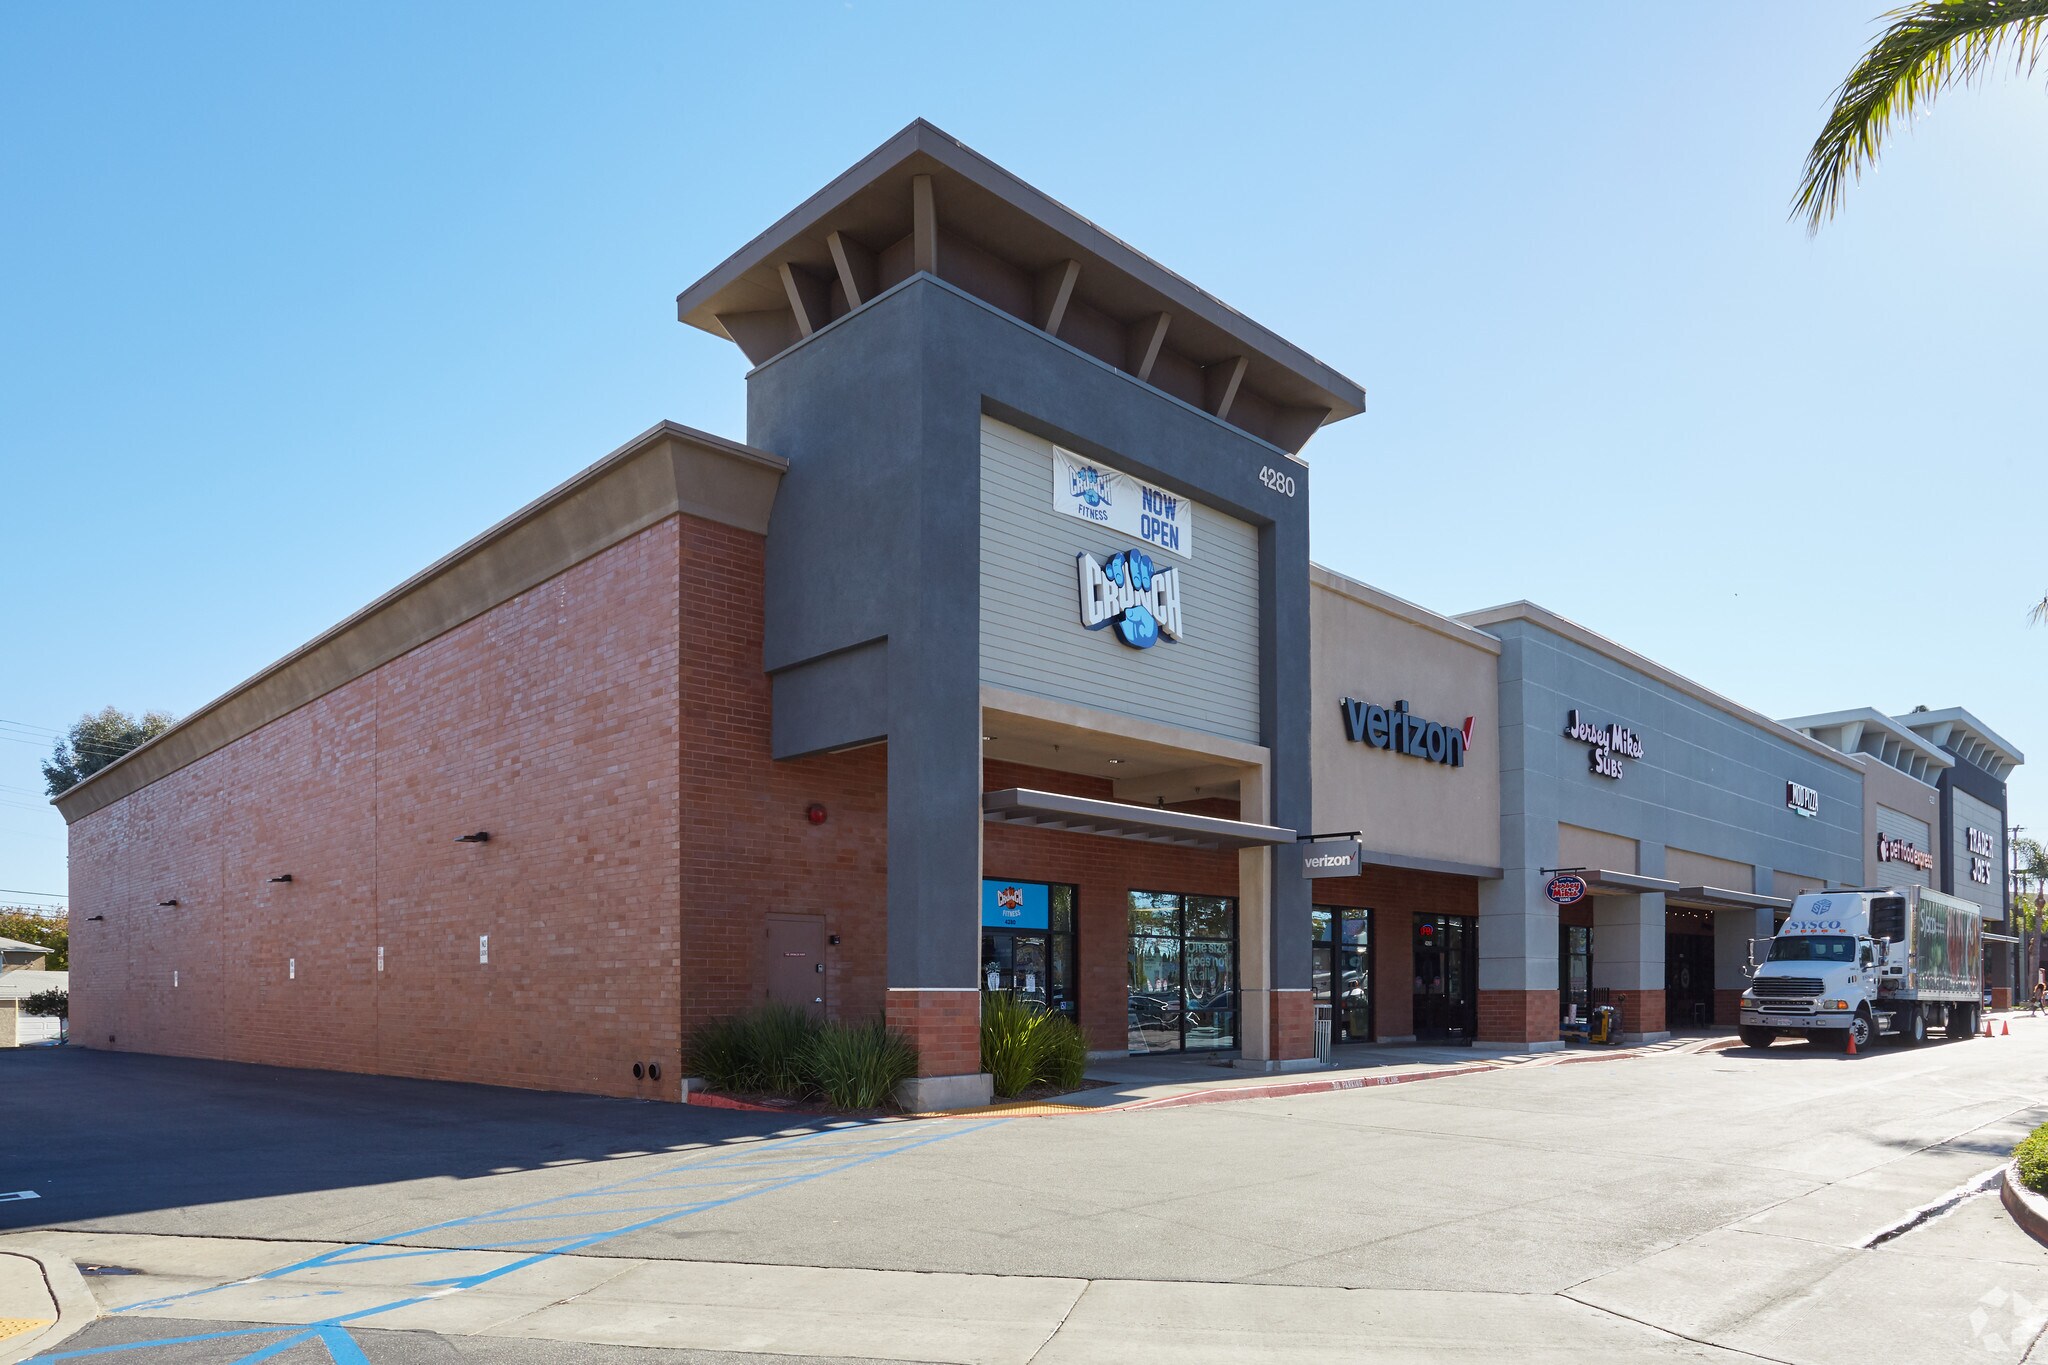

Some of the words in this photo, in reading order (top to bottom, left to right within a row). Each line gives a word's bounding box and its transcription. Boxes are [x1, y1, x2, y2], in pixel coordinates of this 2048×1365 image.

[1069, 465, 1112, 506] CRUNCH
[1259, 465, 1295, 498] 4280
[1078, 503, 1109, 522] FITNESS
[1142, 486, 1177, 522] NOW
[1140, 514, 1180, 551] OPEN
[1077, 551, 1183, 642] CRUNCH
[1340, 696, 1464, 768] verizon
[1569, 709, 1610, 757] Jersey
[1611, 723, 1645, 759] Mike's
[1804, 788, 1819, 812] PIZZA
[1968, 826, 1994, 859] TRADER
[1304, 854, 1351, 868] verizon
[1913, 849, 1933, 871] express
[1971, 857, 1991, 885] JOE'S
[1551, 880, 1580, 891] Jersey
[1552, 888, 1580, 898] Mike's
[1002, 909, 1021, 918] FITNESS
[1790, 920, 1841, 930] SYSCO
[1208, 943, 1228, 954] size
[1341, 1079, 1363, 1090] PARKING
